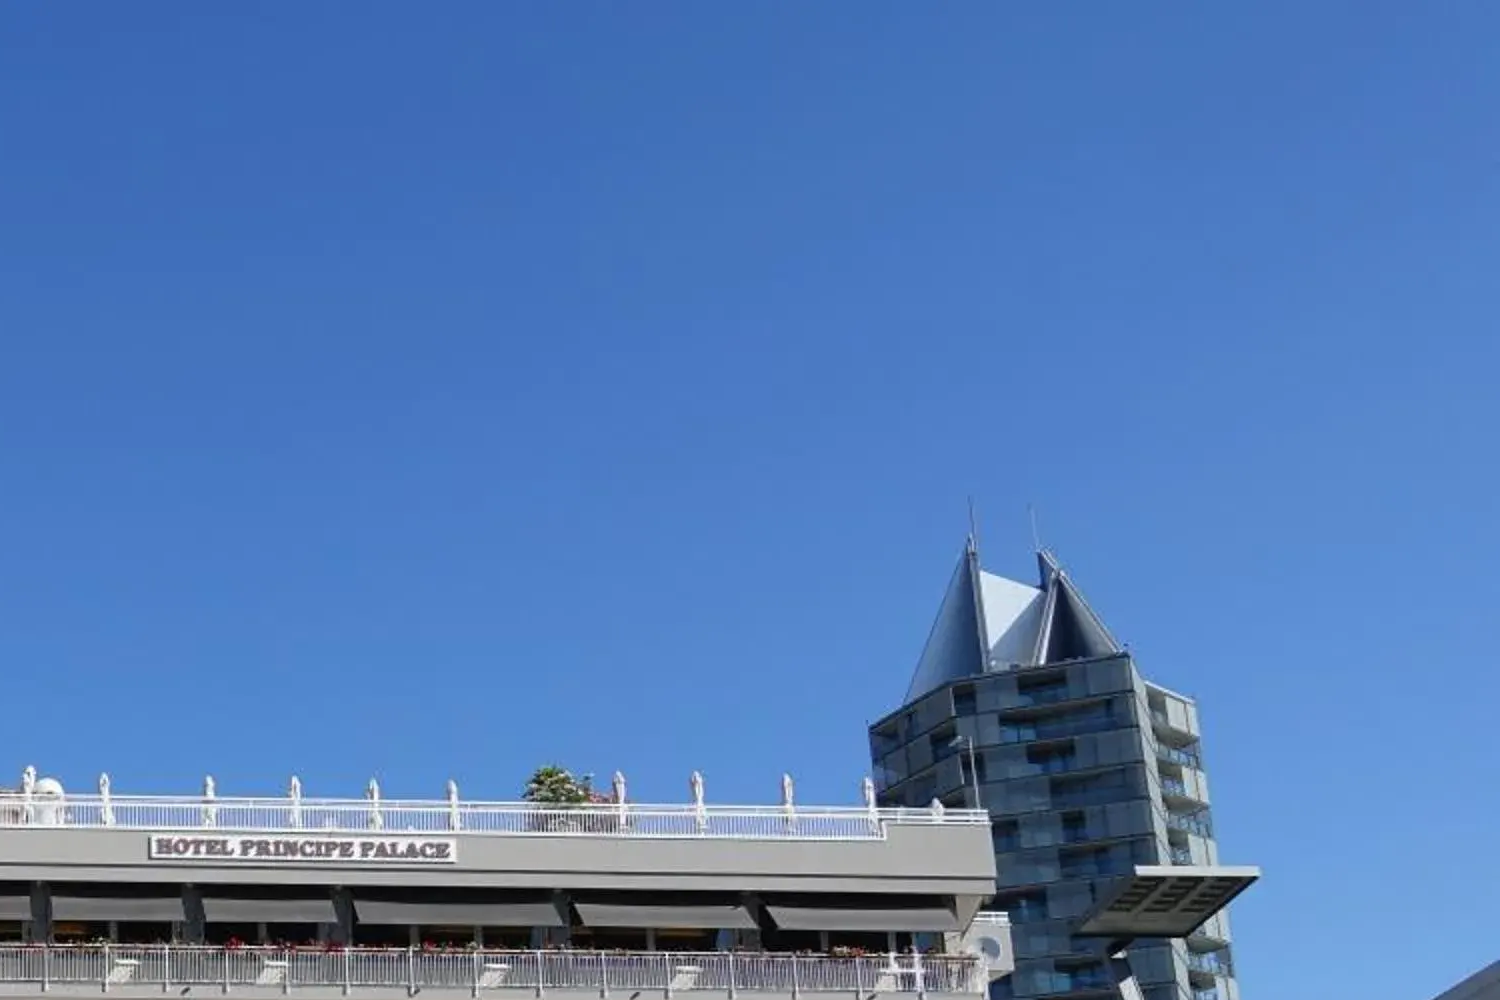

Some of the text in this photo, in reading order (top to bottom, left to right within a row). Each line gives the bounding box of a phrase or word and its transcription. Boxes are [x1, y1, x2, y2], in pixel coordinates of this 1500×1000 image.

[155, 837, 451, 860] HOTEL PRINCIPE PALACE
